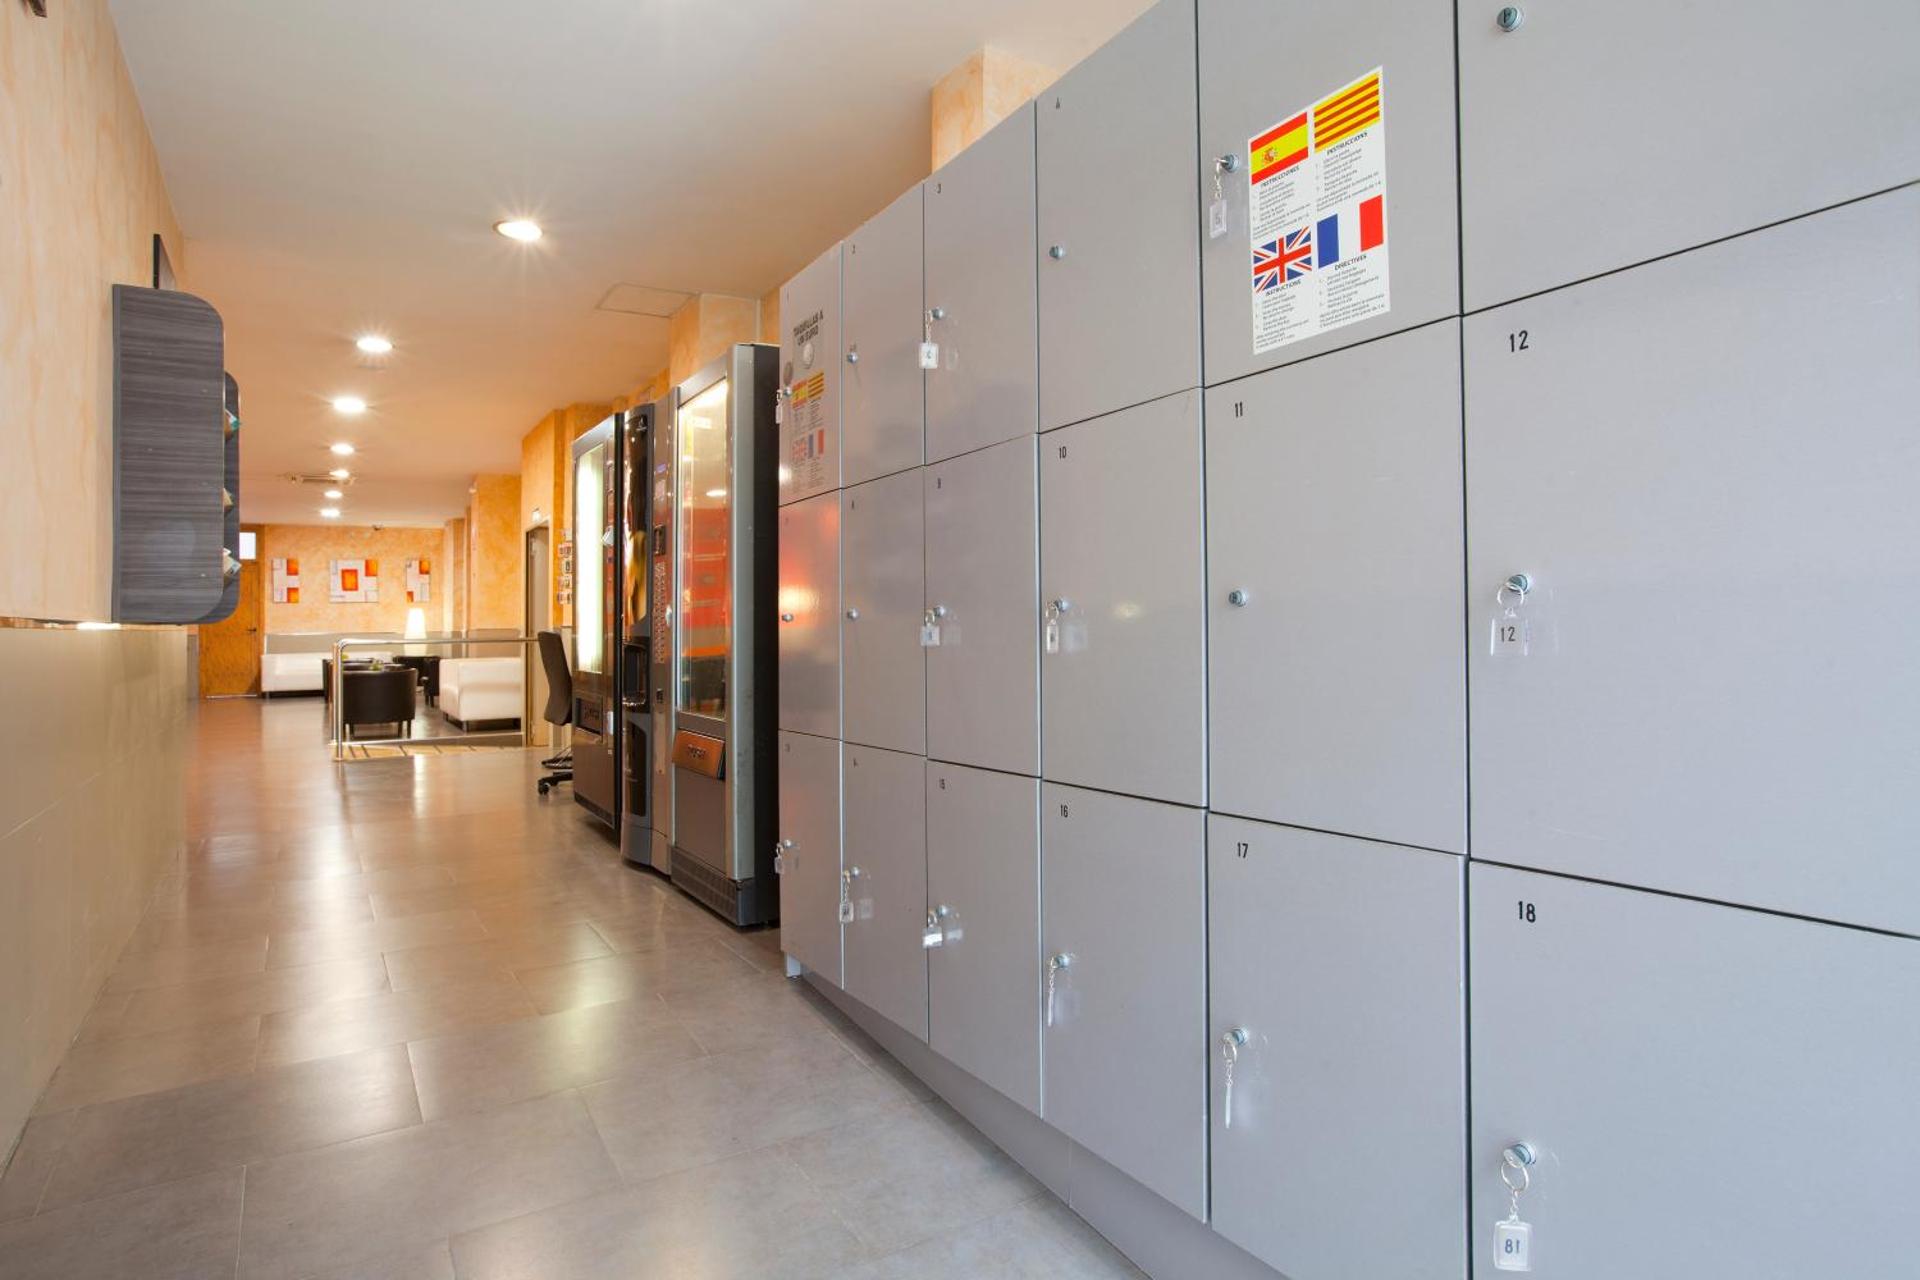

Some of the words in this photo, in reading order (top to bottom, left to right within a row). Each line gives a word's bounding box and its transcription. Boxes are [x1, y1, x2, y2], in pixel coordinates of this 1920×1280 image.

[1509, 330, 1529, 352] 12
[1234, 401, 1244, 418] 11
[1059, 446, 1067, 460] 10
[1501, 626, 1516, 643] 12
[1060, 804, 1069, 818] 16
[1237, 842, 1249, 859] 17
[1518, 901, 1536, 923] 18
